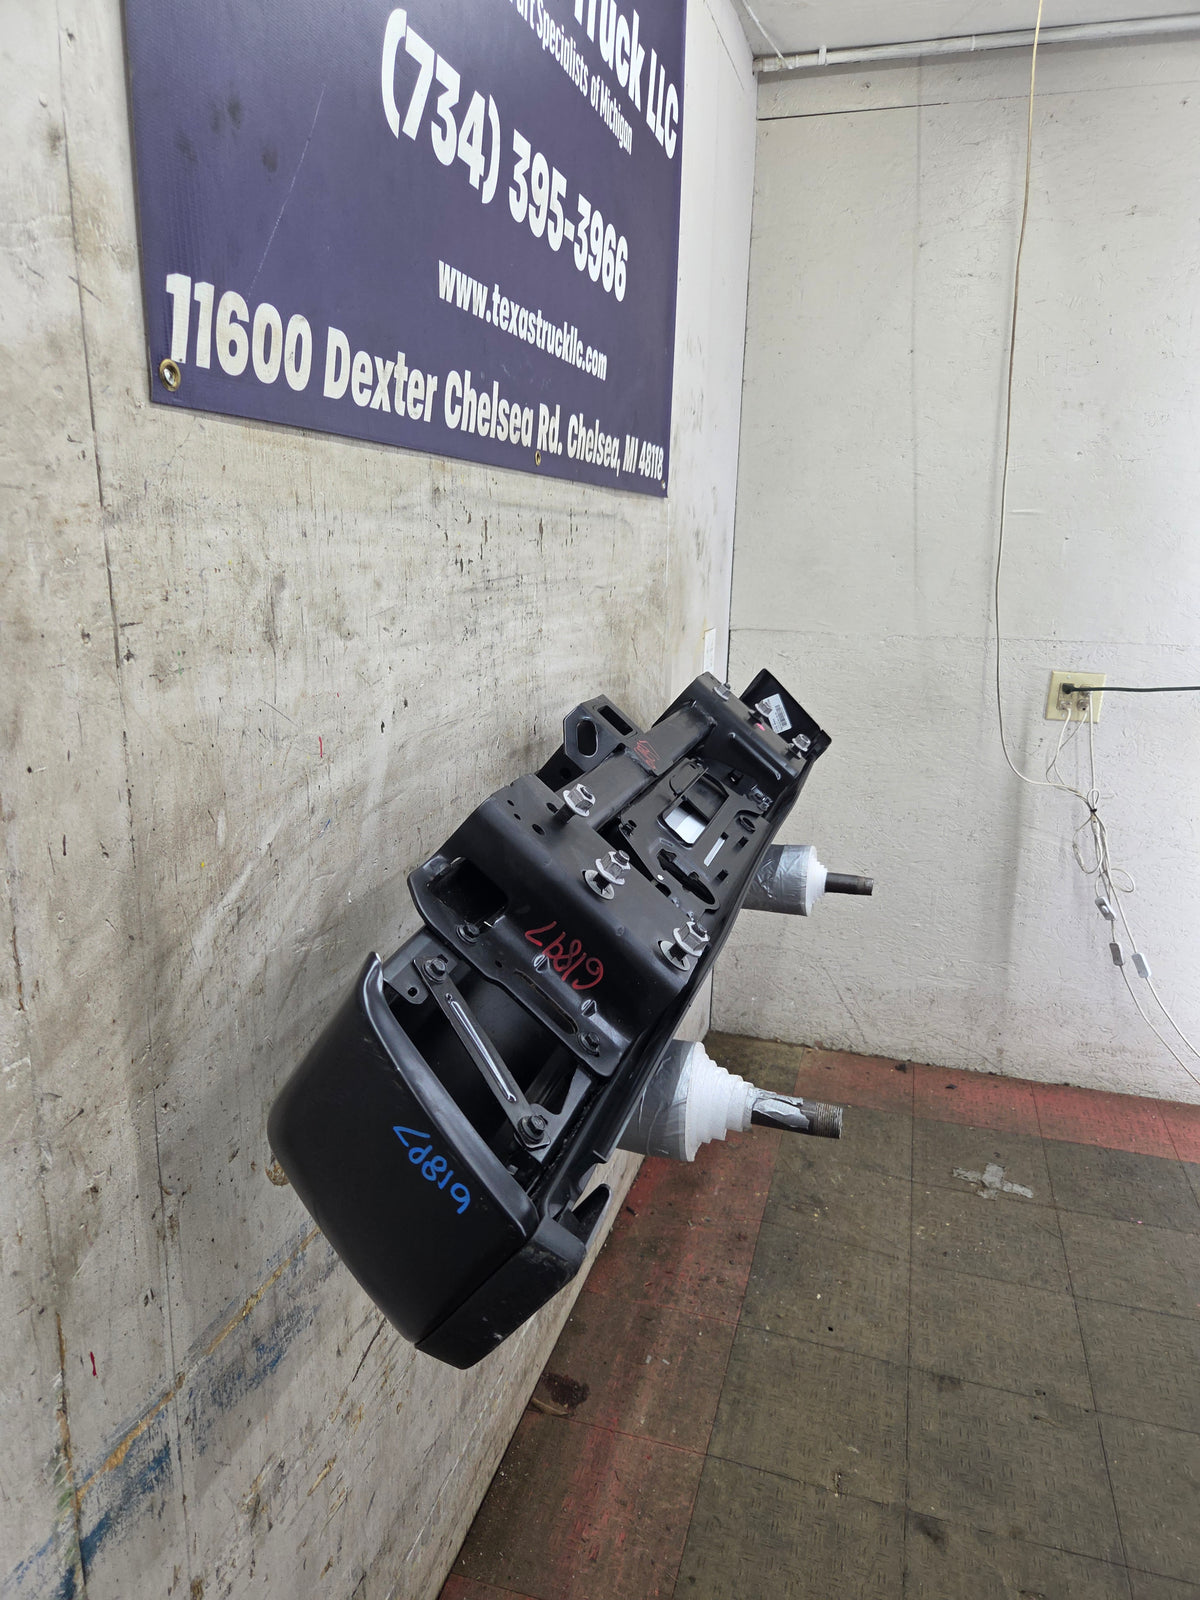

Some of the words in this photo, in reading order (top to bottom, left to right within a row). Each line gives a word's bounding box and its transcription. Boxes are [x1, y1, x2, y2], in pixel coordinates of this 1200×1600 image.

[382, 8, 501, 205] (734)
[509, 128, 629, 302] 395-3966
[536, 0, 589, 97] Specialists
[590, 75, 601, 112] of
[600, 79, 633, 156] Michigan
[573, 0, 646, 113] ruck
[646, 48, 679, 160] LLC
[165, 272, 313, 392] 11600
[323, 326, 438, 423] Dexter
[444, 369, 534, 448] Chelsea
[536, 403, 563, 456] Rd.
[567, 413, 621, 477] Chelsea,
[622, 434, 639, 473] MI
[638, 440, 665, 481] 48118
[438, 259, 608, 381] www.texastruckllc.com
[524, 920, 605, 990] 61897
